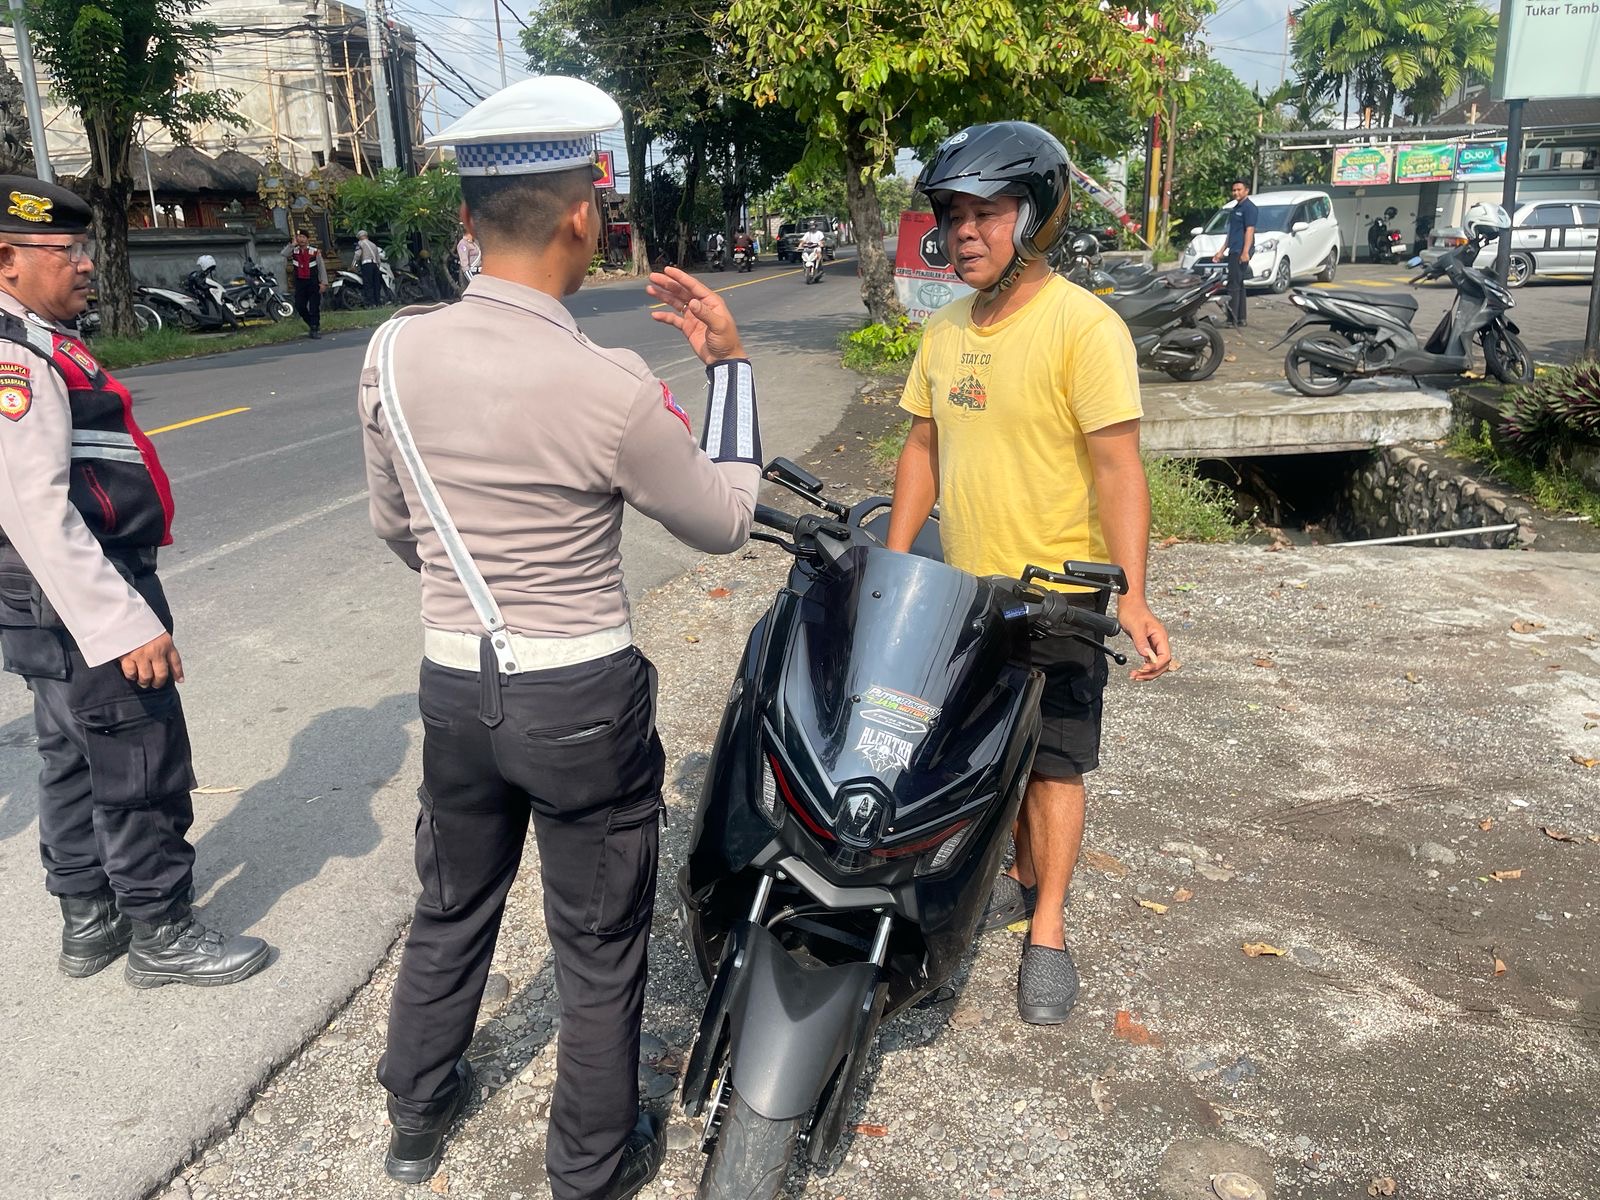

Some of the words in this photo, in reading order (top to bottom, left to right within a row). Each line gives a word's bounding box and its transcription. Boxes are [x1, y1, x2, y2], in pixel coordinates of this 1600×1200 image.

[1525, 5, 1560, 16] Tukar
[1564, 2, 1600, 15] Tamb
[911, 309, 932, 318] TOY
[961, 353, 991, 365] STAY.CO
[0, 364, 26, 374] AMAPTA
